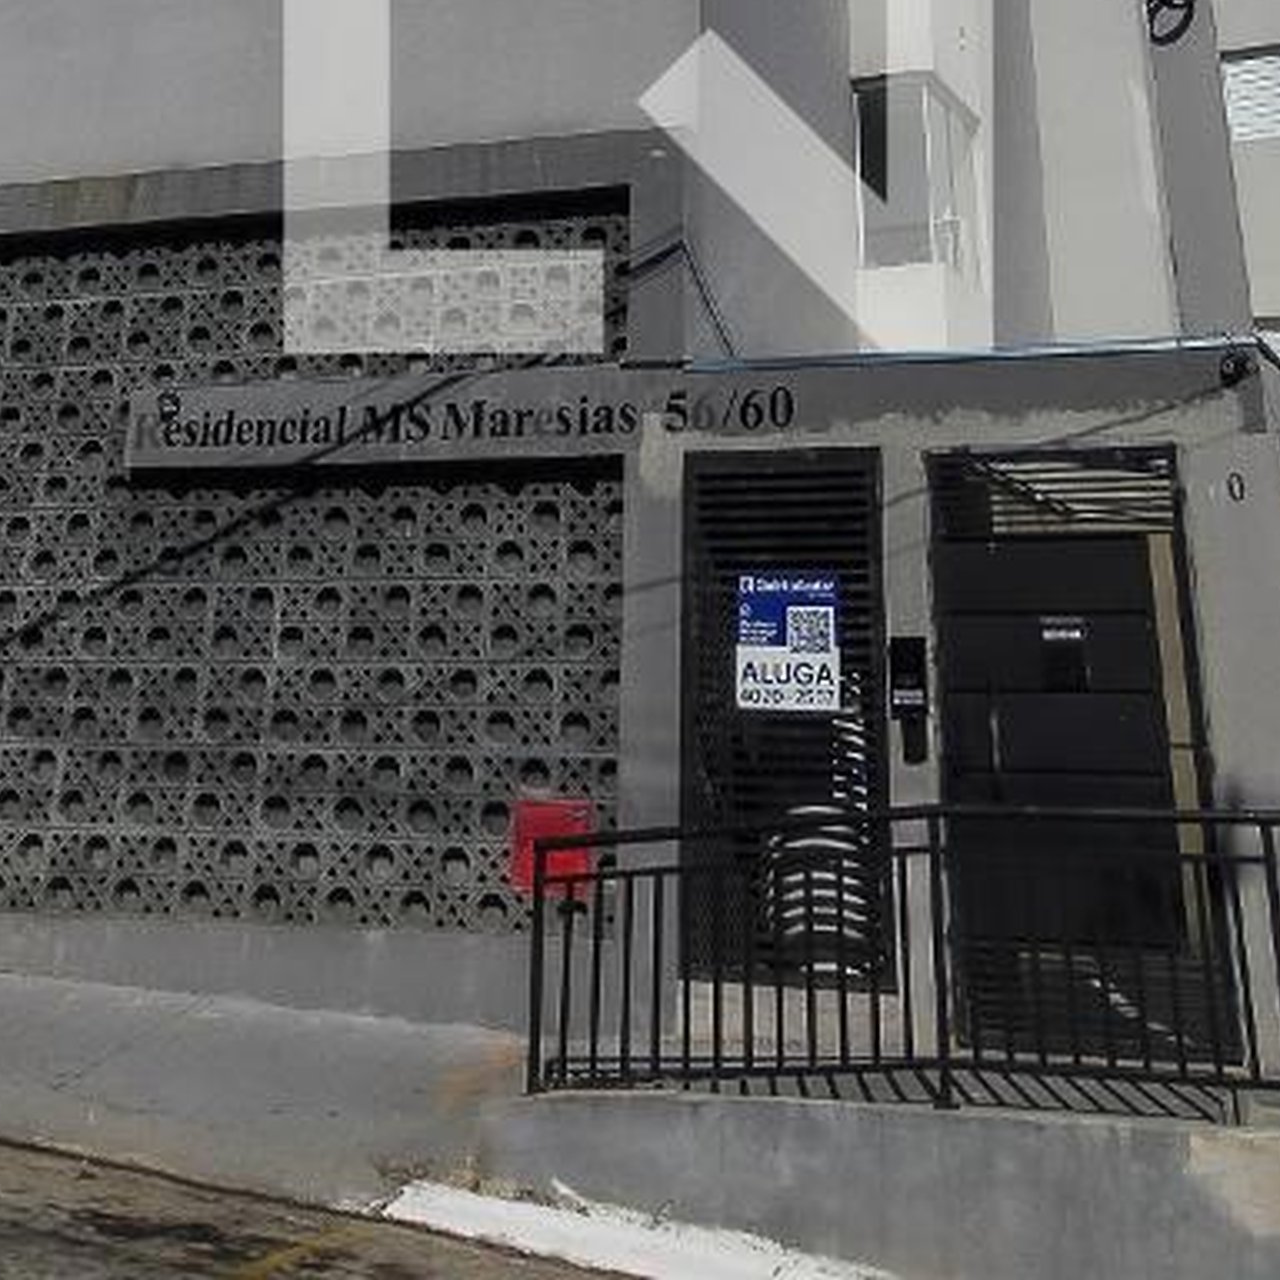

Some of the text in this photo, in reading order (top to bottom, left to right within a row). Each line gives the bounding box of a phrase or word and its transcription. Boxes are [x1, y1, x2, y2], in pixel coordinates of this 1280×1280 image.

[363, 404, 431, 443] MS
[664, 385, 795, 431] 56/60
[741, 661, 834, 686] ALUGA
